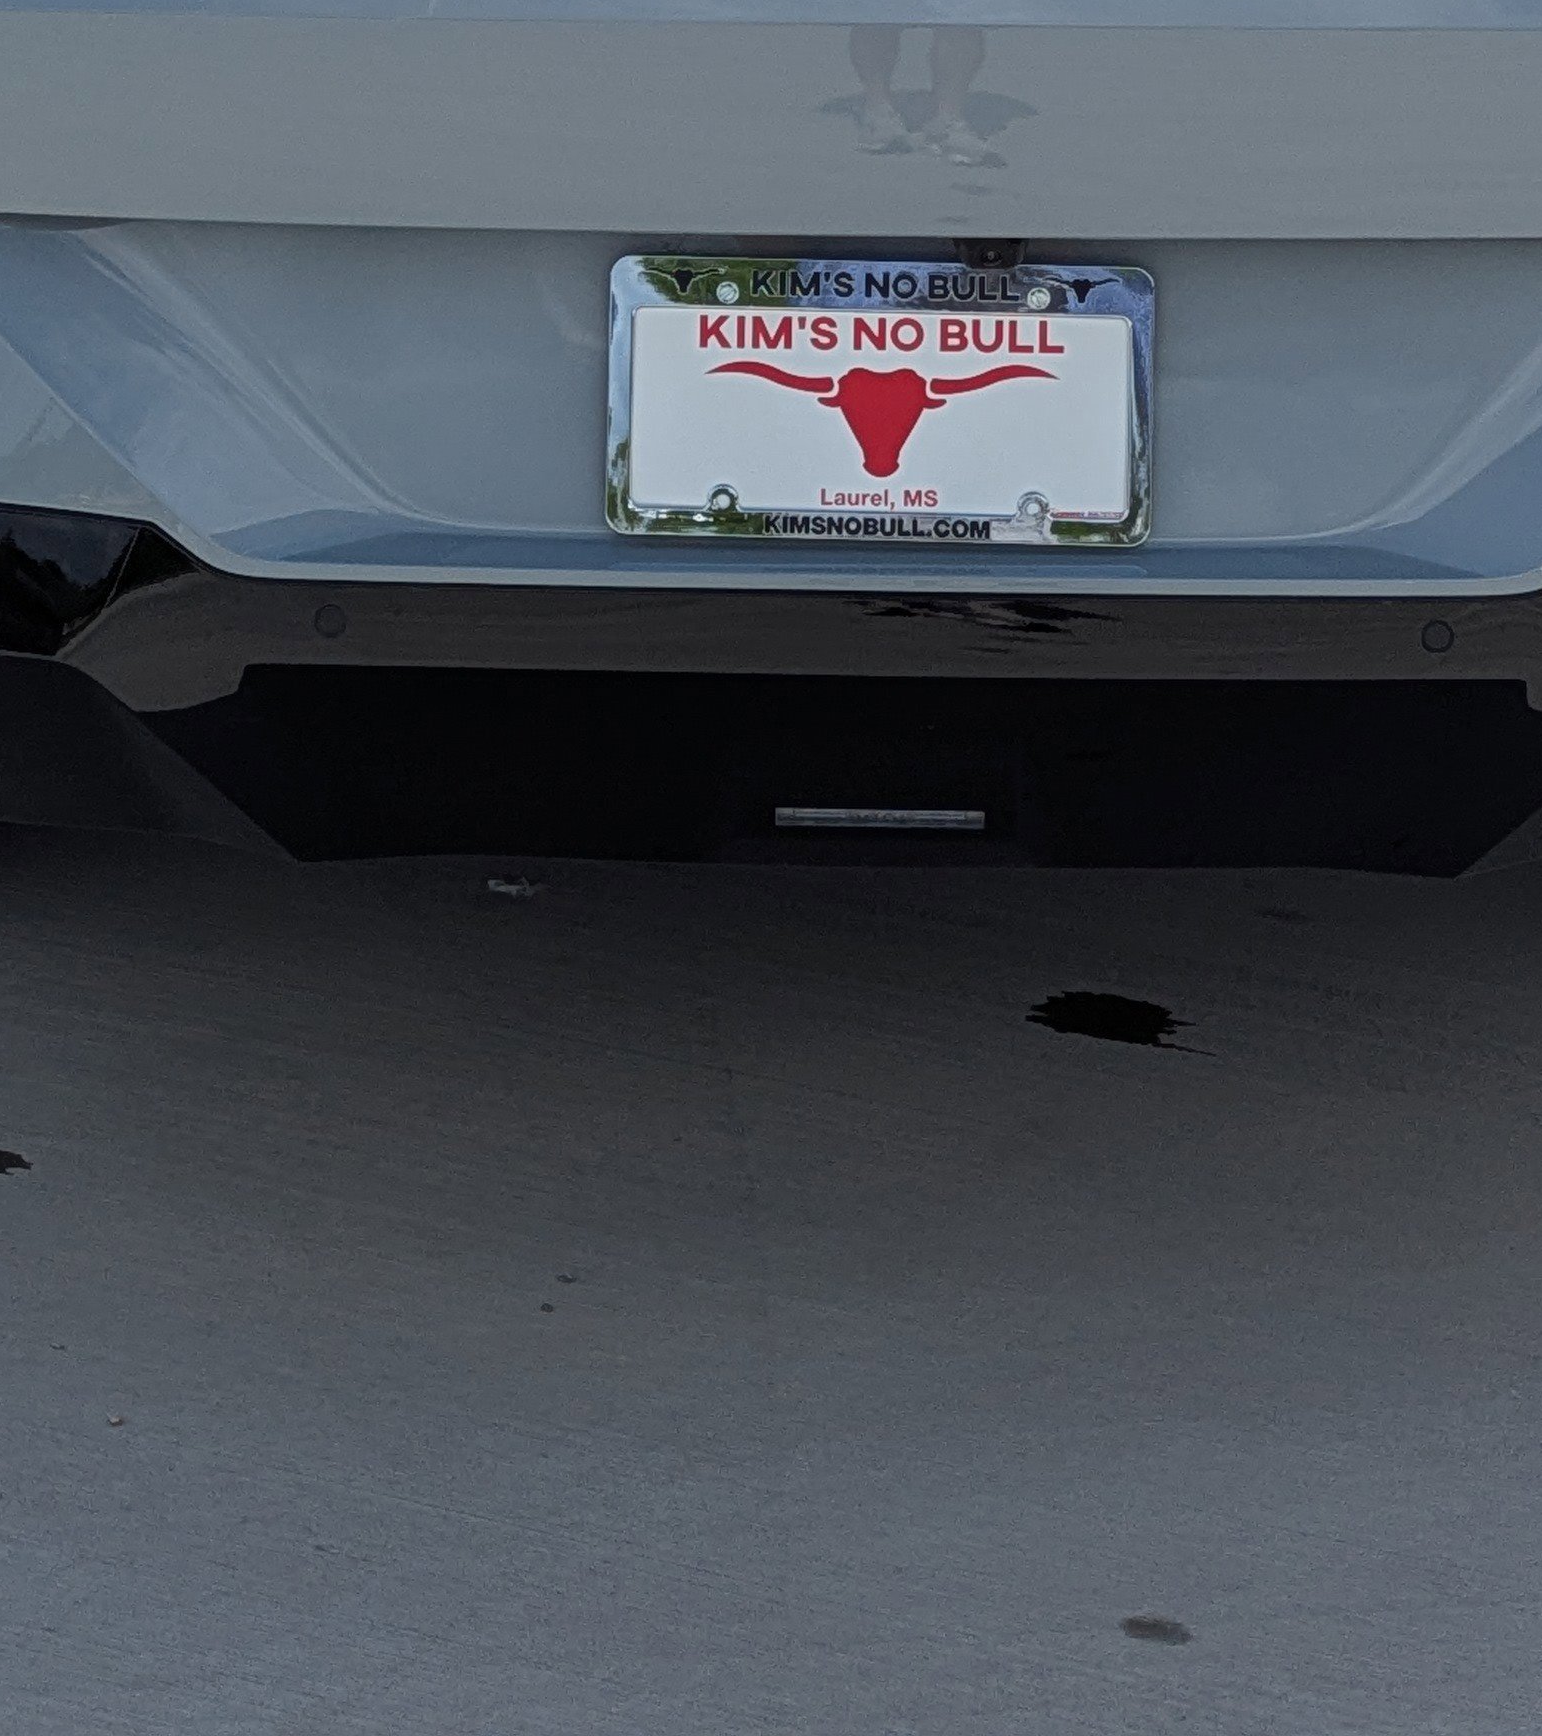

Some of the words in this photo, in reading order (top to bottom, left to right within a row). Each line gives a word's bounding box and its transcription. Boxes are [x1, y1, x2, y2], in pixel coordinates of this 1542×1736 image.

[751, 269, 855, 300] KIM'S
[864, 271, 918, 300] NO
[928, 273, 1020, 302] BULL
[699, 314, 838, 351] KIM'S
[853, 316, 925, 352] NO
[939, 319, 1065, 354] BULL
[820, 488, 895, 510] Laurel,
[903, 489, 938, 507] MS
[762, 514, 991, 540] KIMSNOBULL.COM
